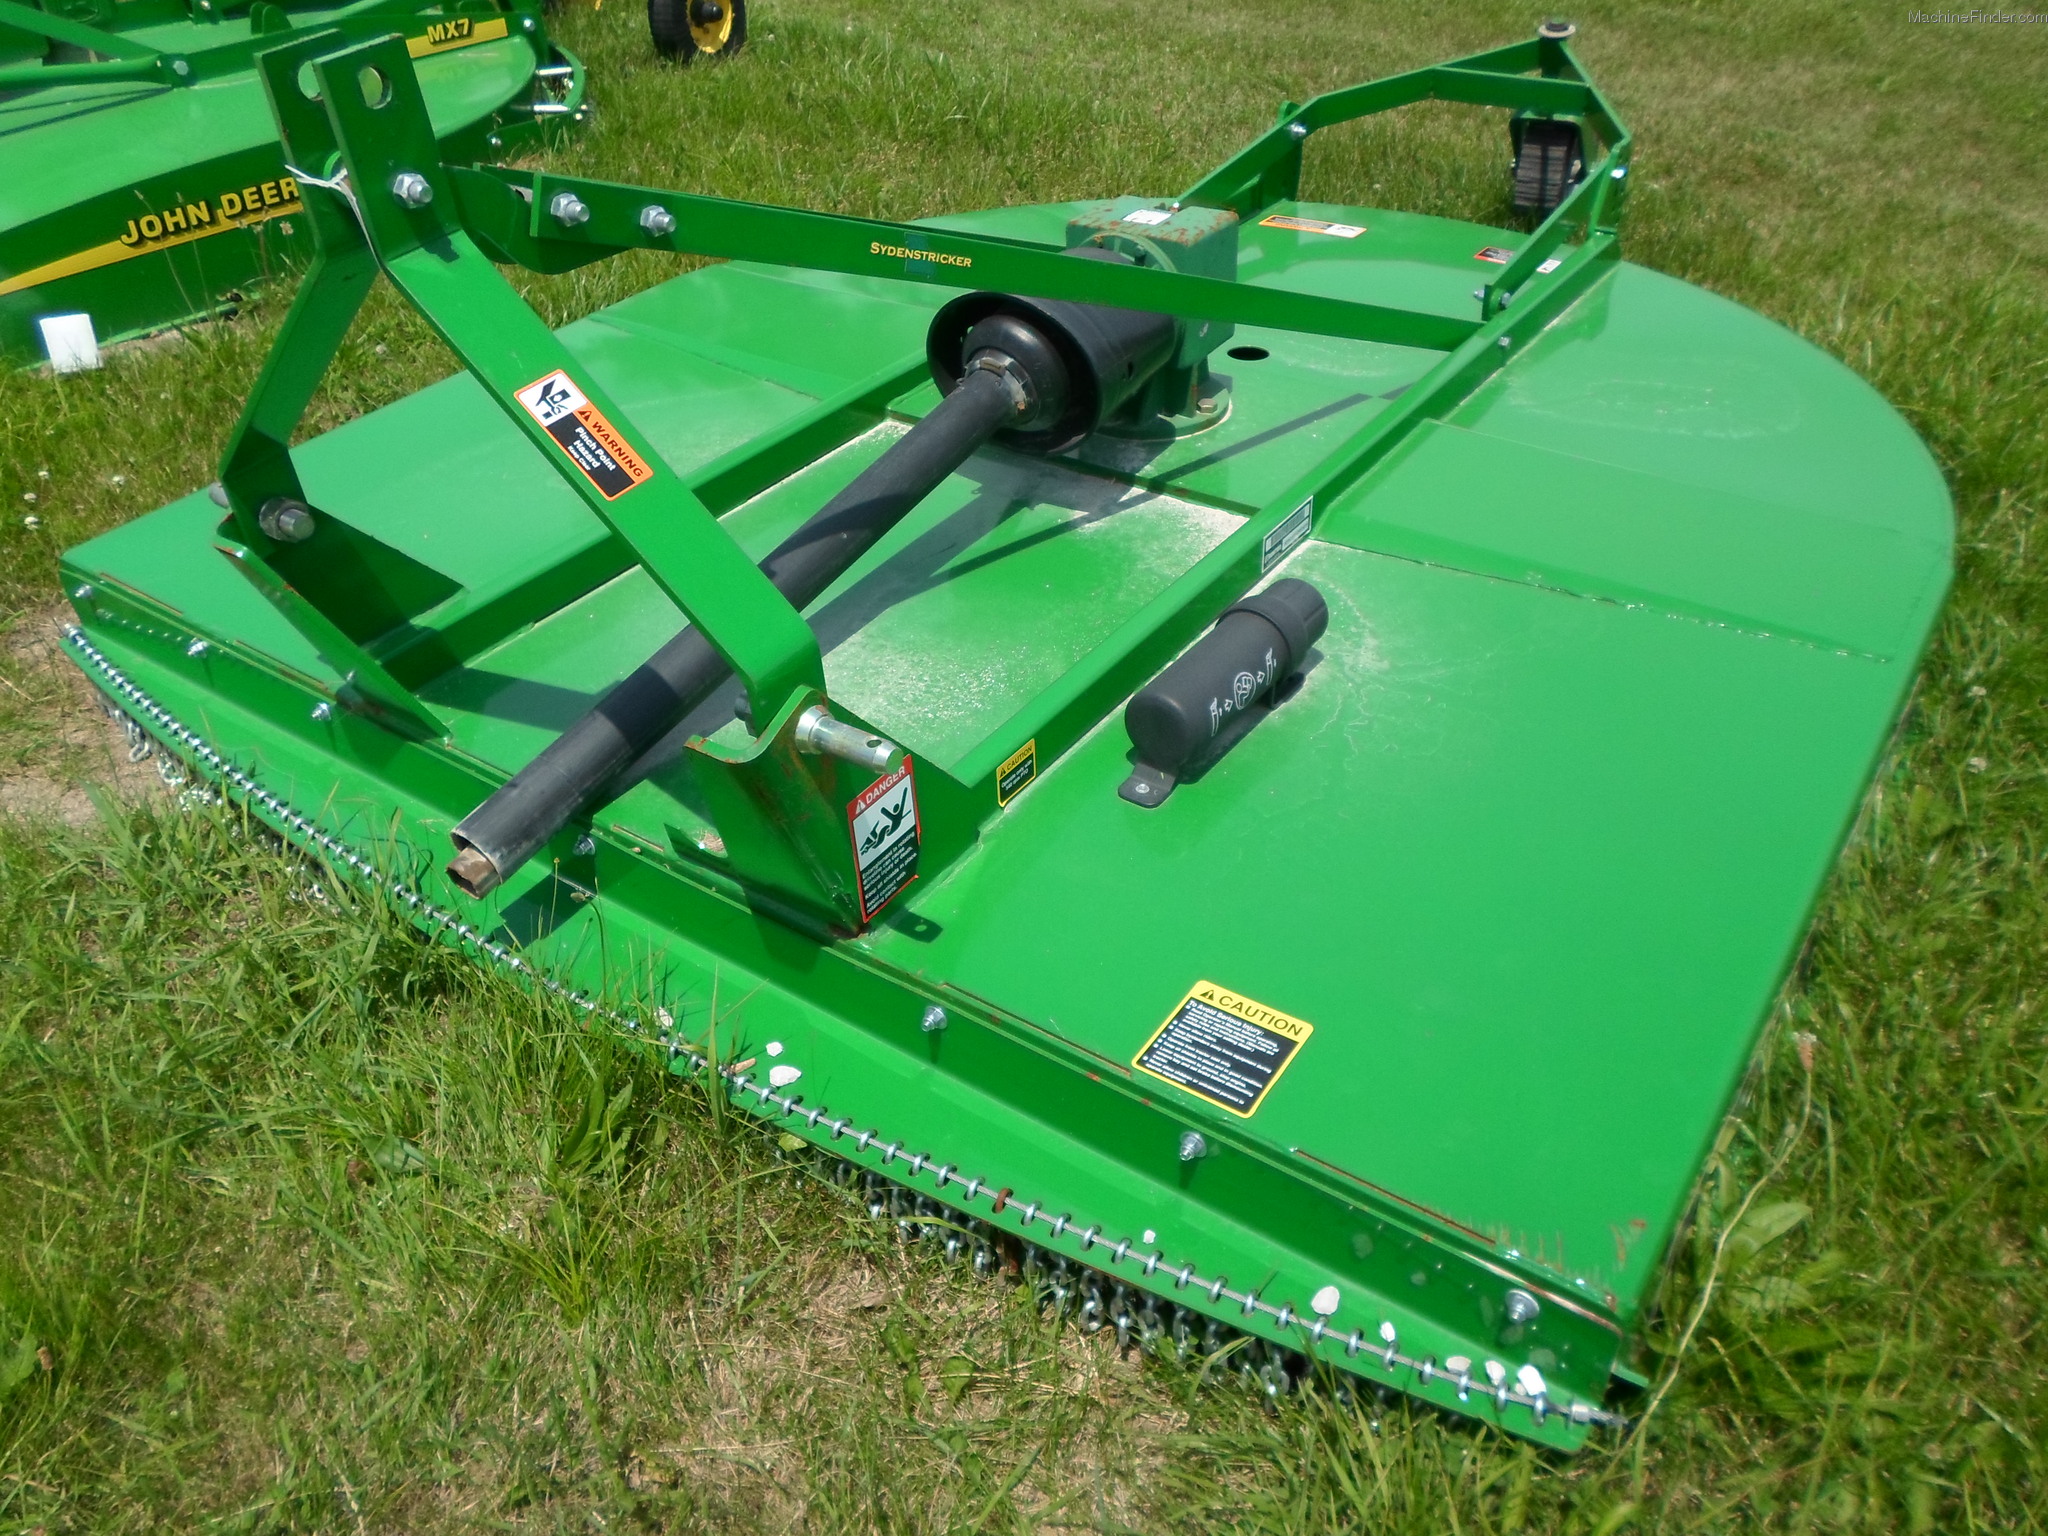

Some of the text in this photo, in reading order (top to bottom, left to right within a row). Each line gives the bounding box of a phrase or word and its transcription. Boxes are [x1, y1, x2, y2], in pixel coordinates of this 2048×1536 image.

[427, 18, 469, 43] MX7
[121, 201, 210, 244] JOHN
[572, 439, 601, 468] Hazard
[573, 426, 617, 471] Pinch Point
[590, 421, 644, 477] WARNING
[1007, 745, 1032, 770] CAUTION
[865, 764, 905, 805] DANGER
[1219, 995, 1303, 1036] CAUTION
